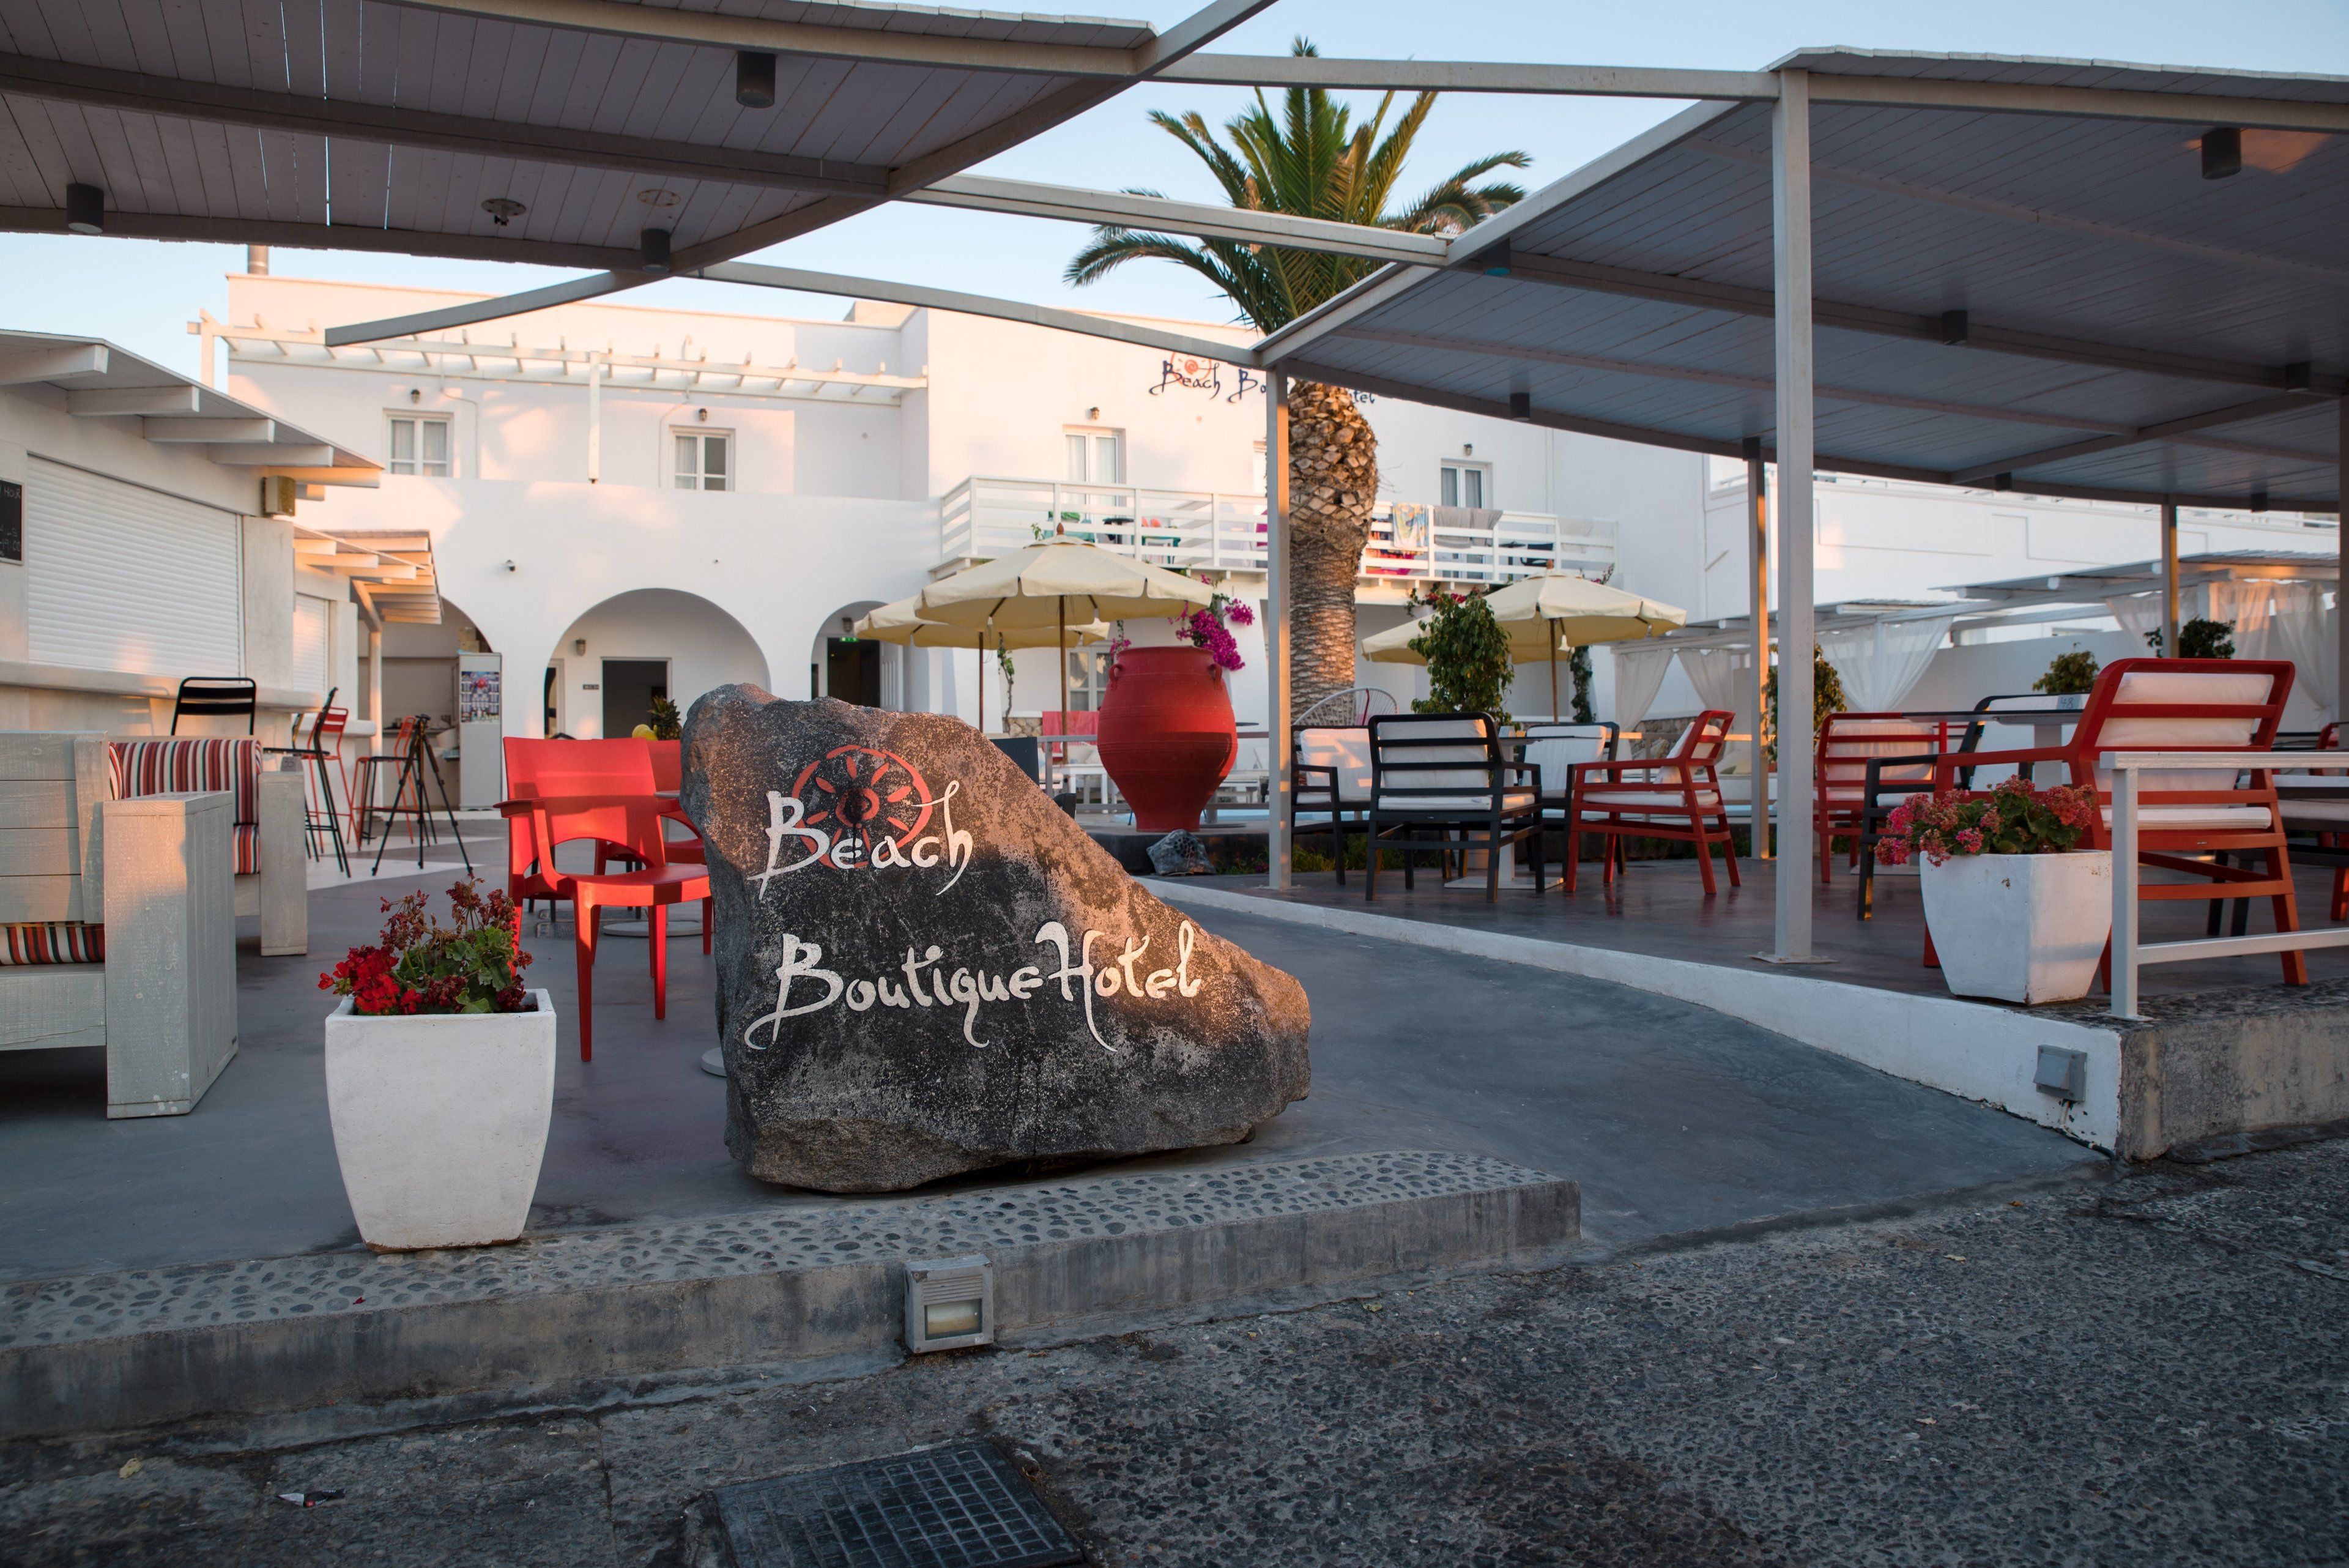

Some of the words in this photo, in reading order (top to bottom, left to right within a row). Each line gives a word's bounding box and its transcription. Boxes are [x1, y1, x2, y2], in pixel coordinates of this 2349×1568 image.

[1148, 360, 1220, 400] Beach
[2060, 696, 2074, 708] 48
[748, 780, 973, 900] Beach
[744, 933, 1044, 1050] Boutique
[1034, 920, 1202, 1052] Hotel
